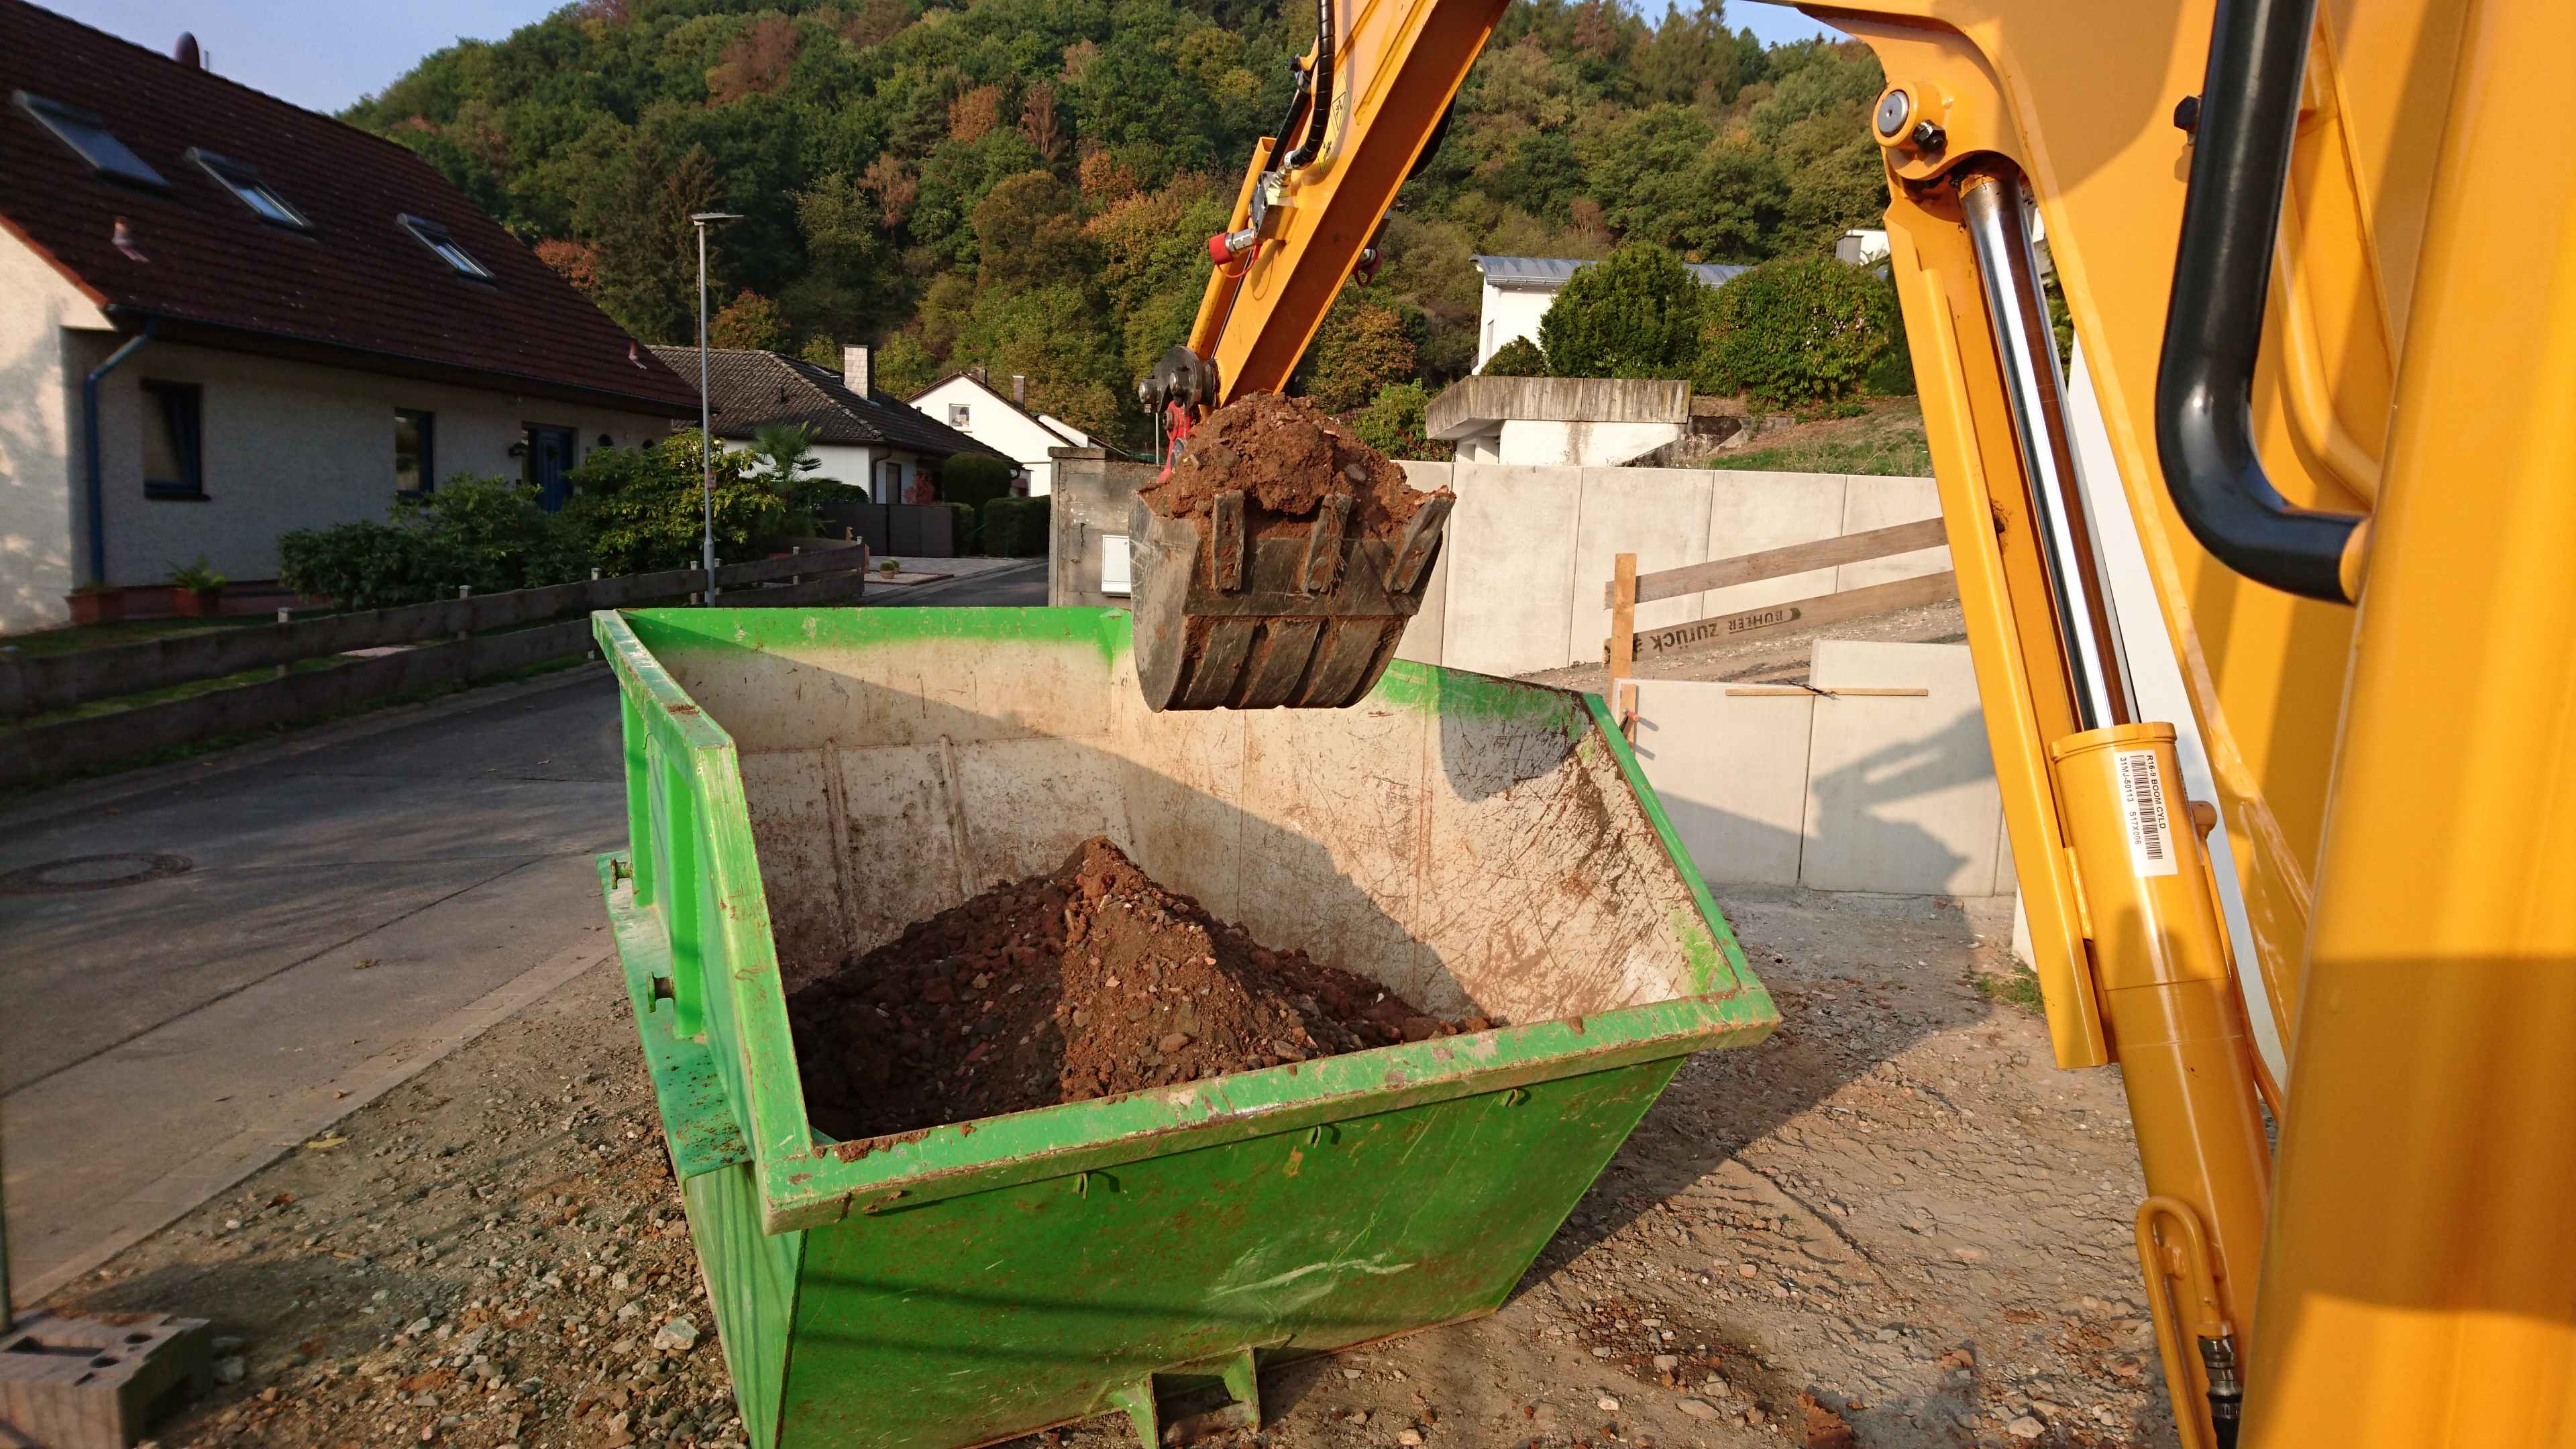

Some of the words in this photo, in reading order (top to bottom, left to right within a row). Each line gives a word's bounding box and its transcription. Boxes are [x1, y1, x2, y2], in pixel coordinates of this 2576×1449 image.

[1650, 623, 1719, 652] zurück
[2147, 755, 2157, 777] R16-9
[2120, 757, 2135, 802] 31MJ-50113
[2151, 779, 2161, 804] BOOM
[2156, 806, 2166, 829] CYLD
